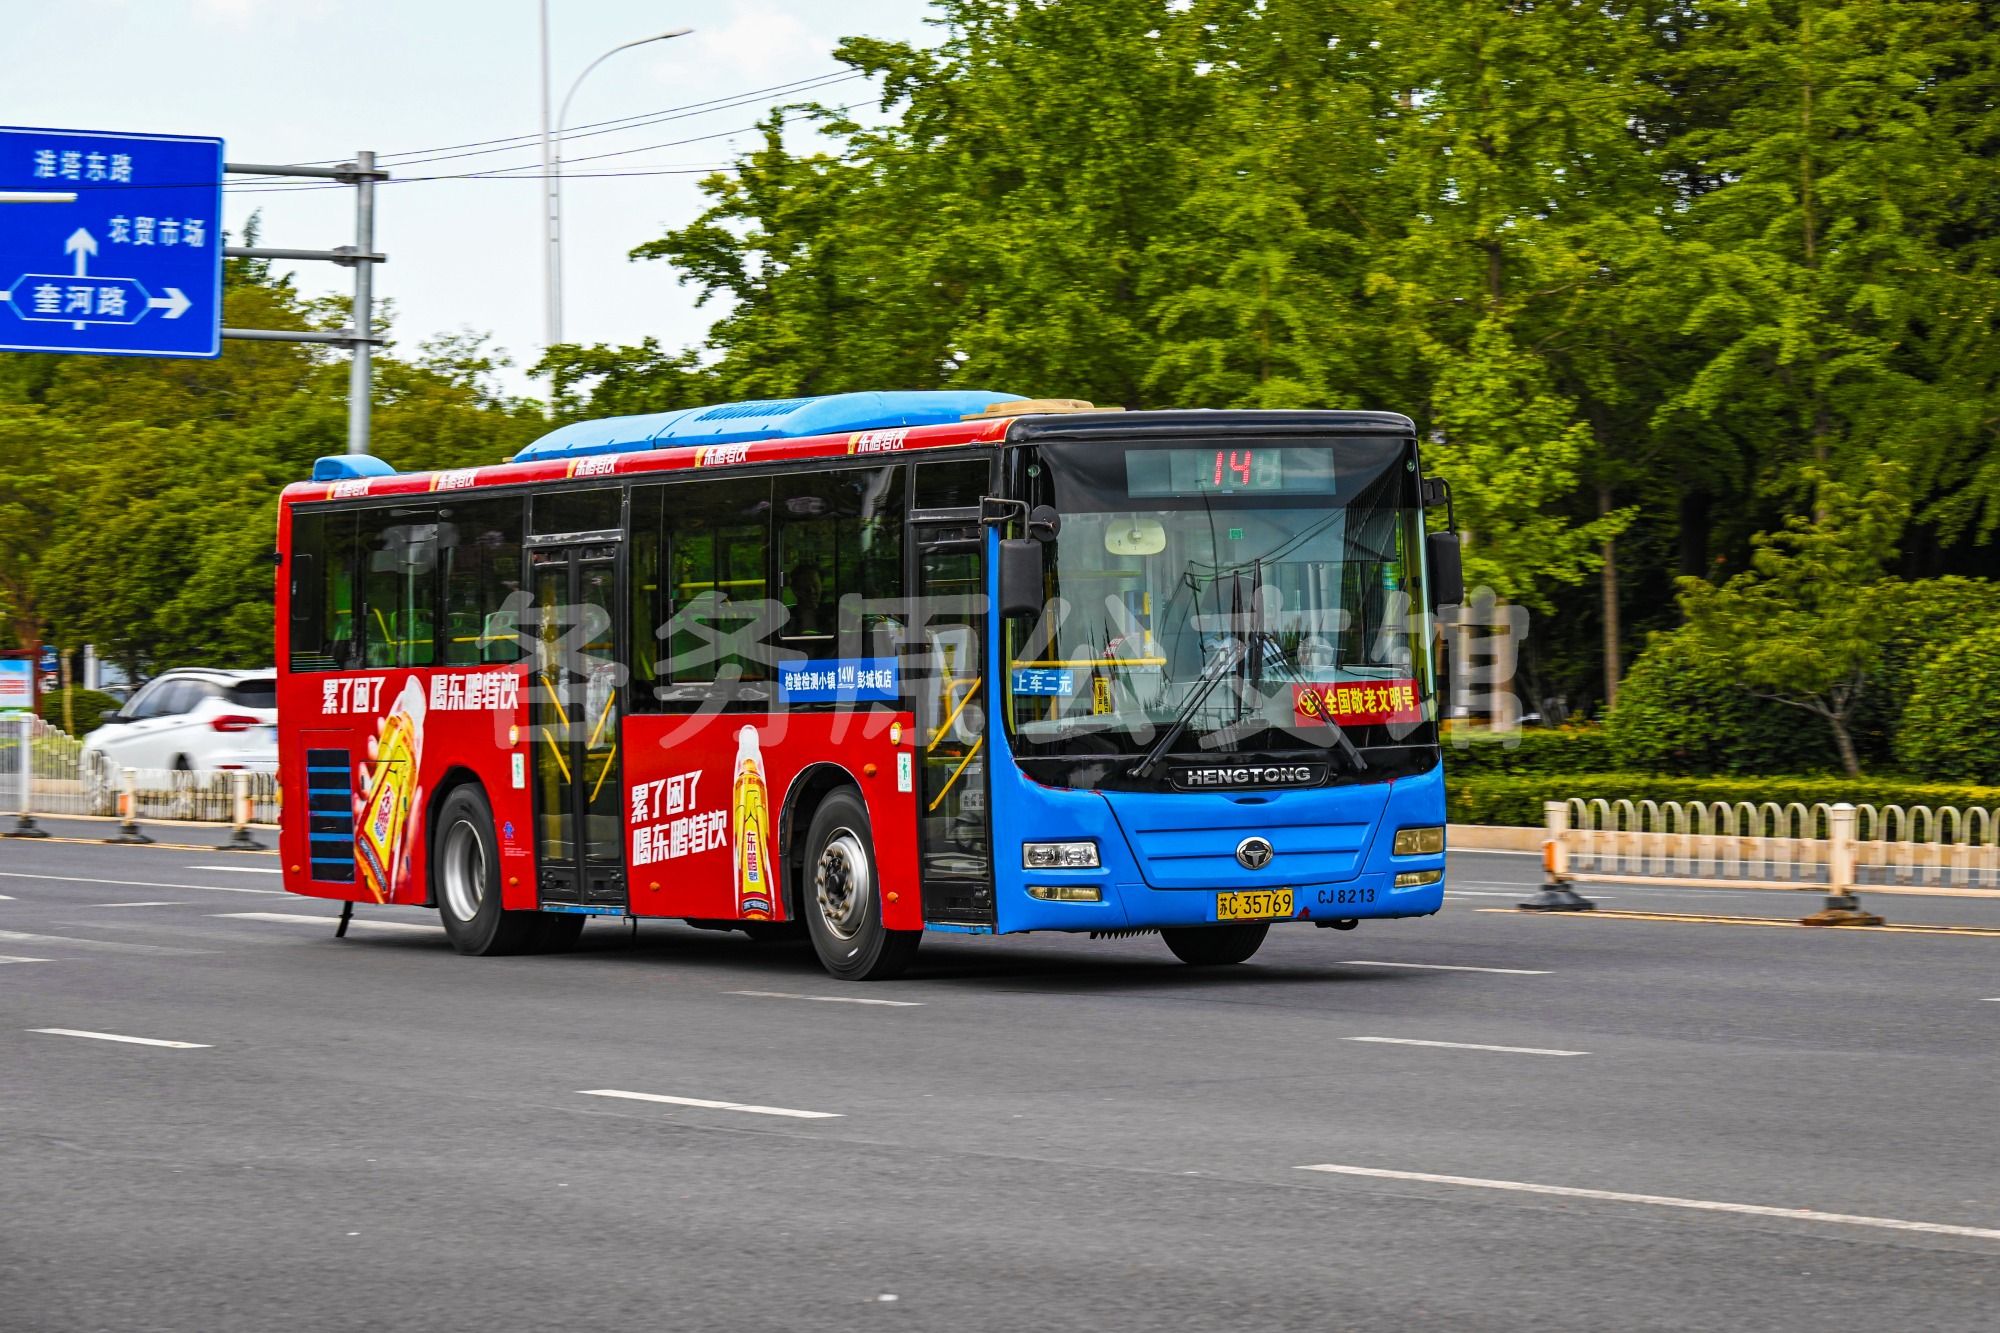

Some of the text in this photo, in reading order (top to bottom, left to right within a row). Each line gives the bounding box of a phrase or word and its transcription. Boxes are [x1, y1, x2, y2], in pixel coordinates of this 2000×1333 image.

[108, 214, 206, 247] 农贸市场
[32, 283, 127, 316] 奎河路
[1214, 451, 1252, 486] 14
[322, 672, 520, 715] 累了困了 喝东鹏特饮
[785, 665, 892, 691] 检验检测小镇 14W 彭城饭店
[1013, 674, 1073, 693] 上车二元
[1324, 686, 1415, 715] 全国敬老文明号
[1187, 767, 1311, 785] HENGTONG
[630, 769, 703, 824] 累了困了
[632, 809, 728, 867] 喝东鹏特饮
